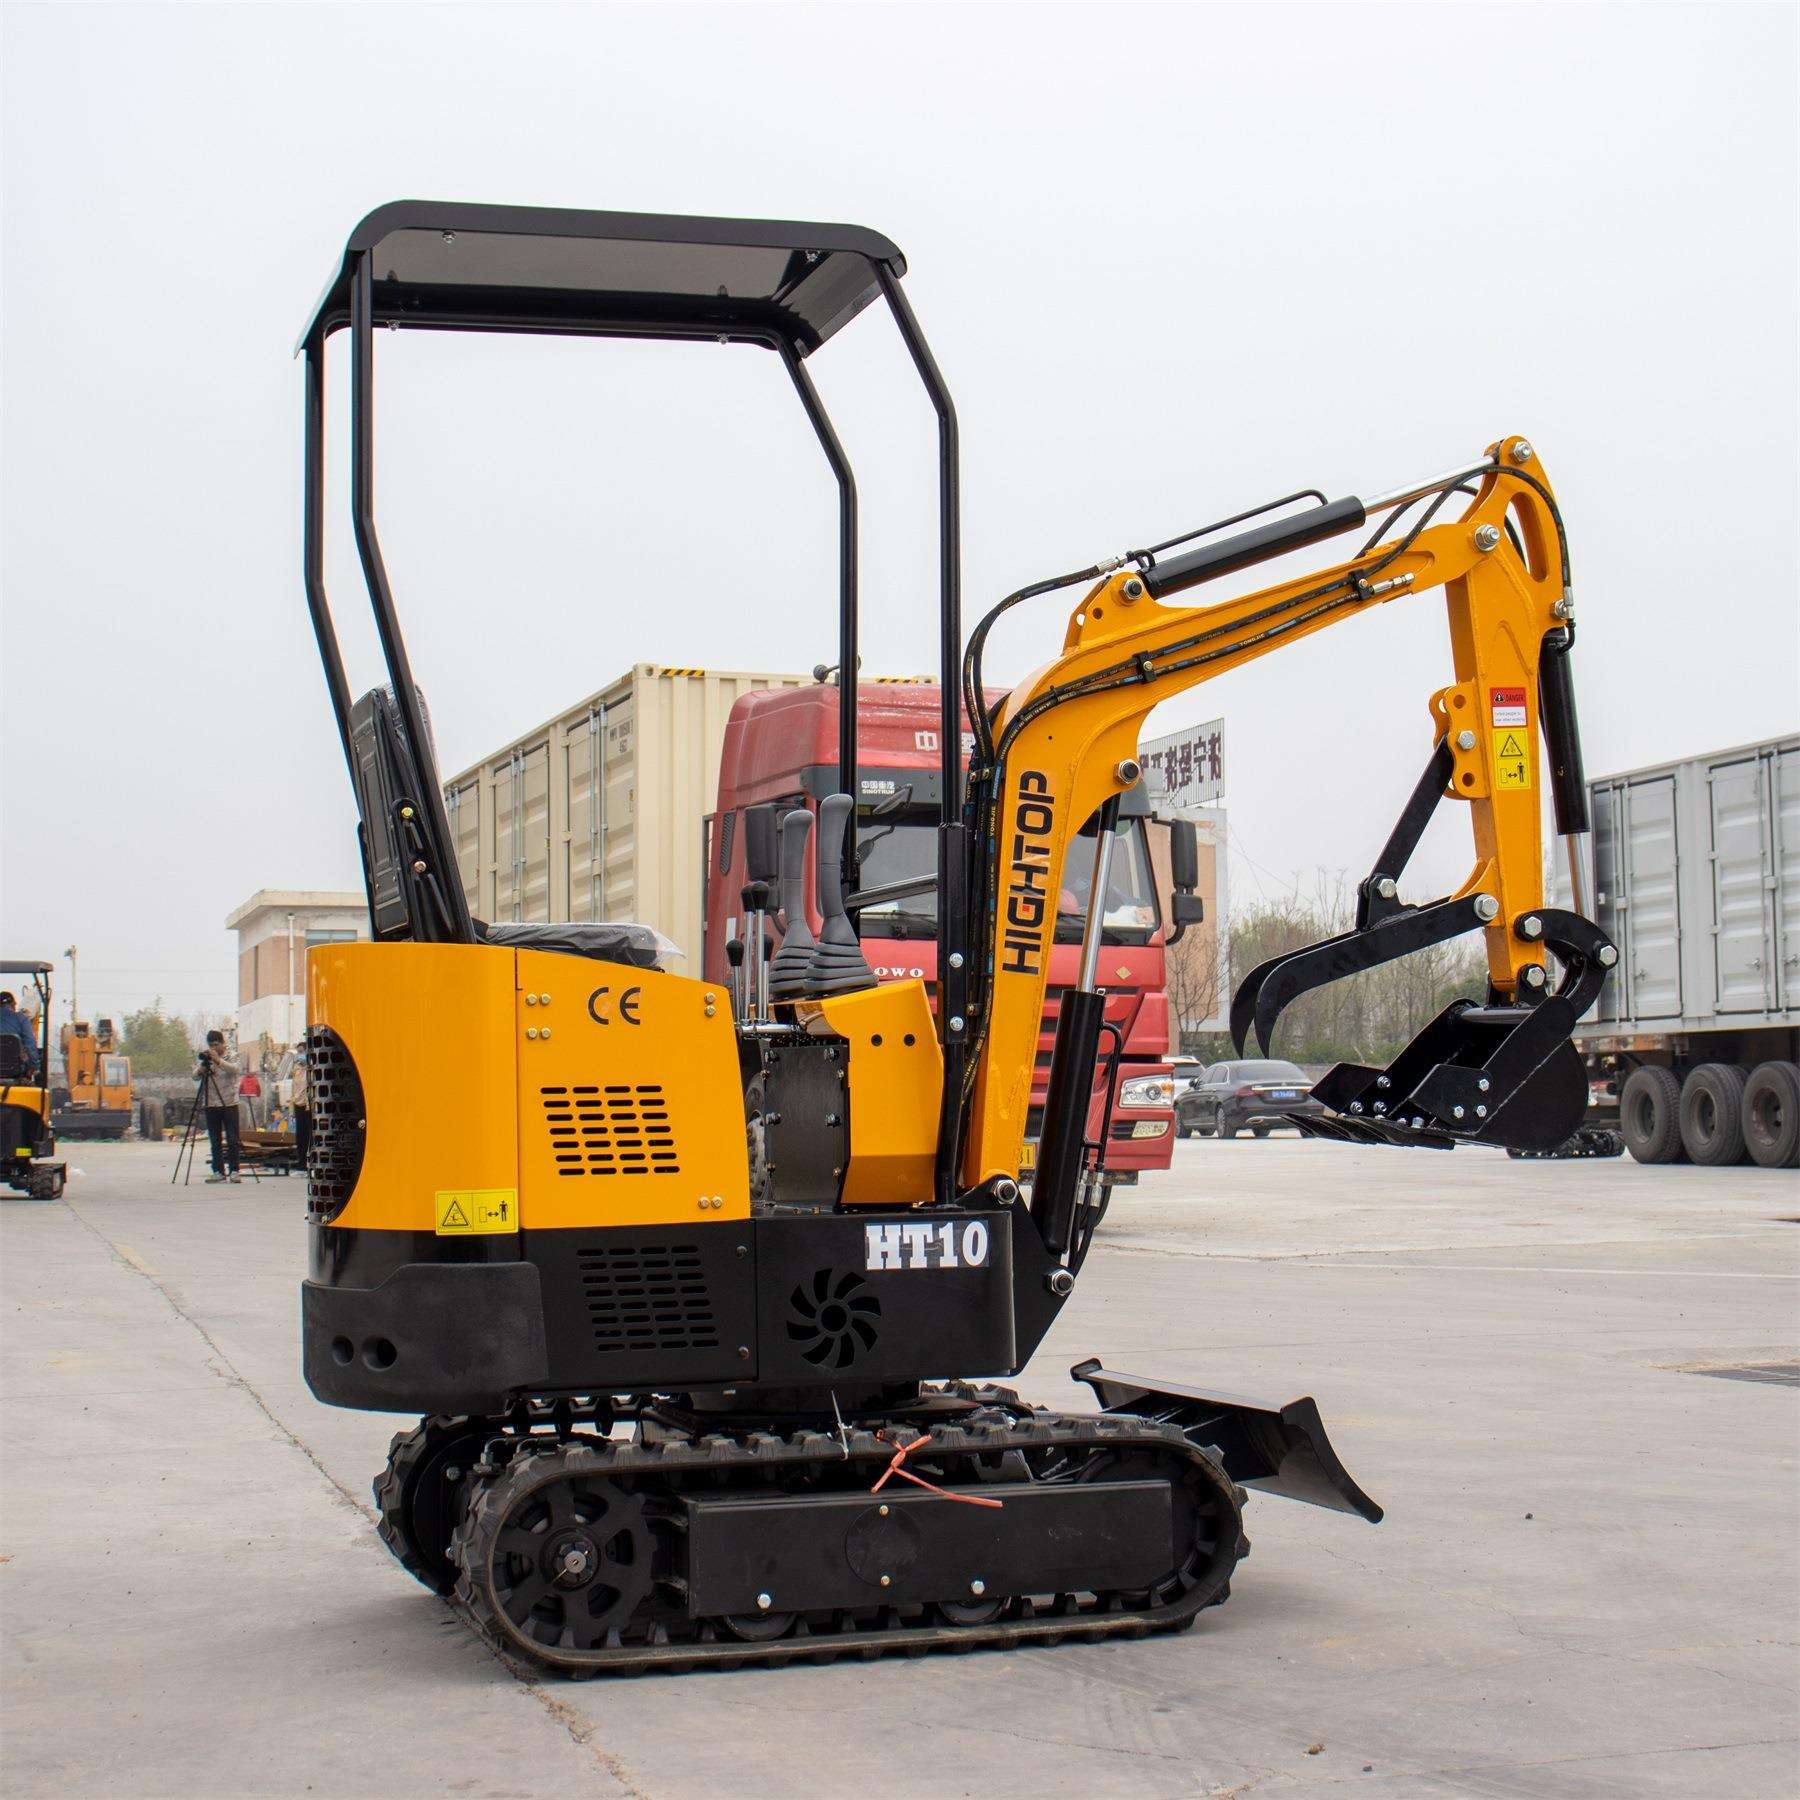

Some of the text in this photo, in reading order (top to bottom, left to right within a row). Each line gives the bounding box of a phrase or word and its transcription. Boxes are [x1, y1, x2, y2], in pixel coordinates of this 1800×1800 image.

[1002, 770, 1054, 975] HIGHTOP
[588, 986, 641, 1026] CE
[866, 1221, 988, 1270] HT10
